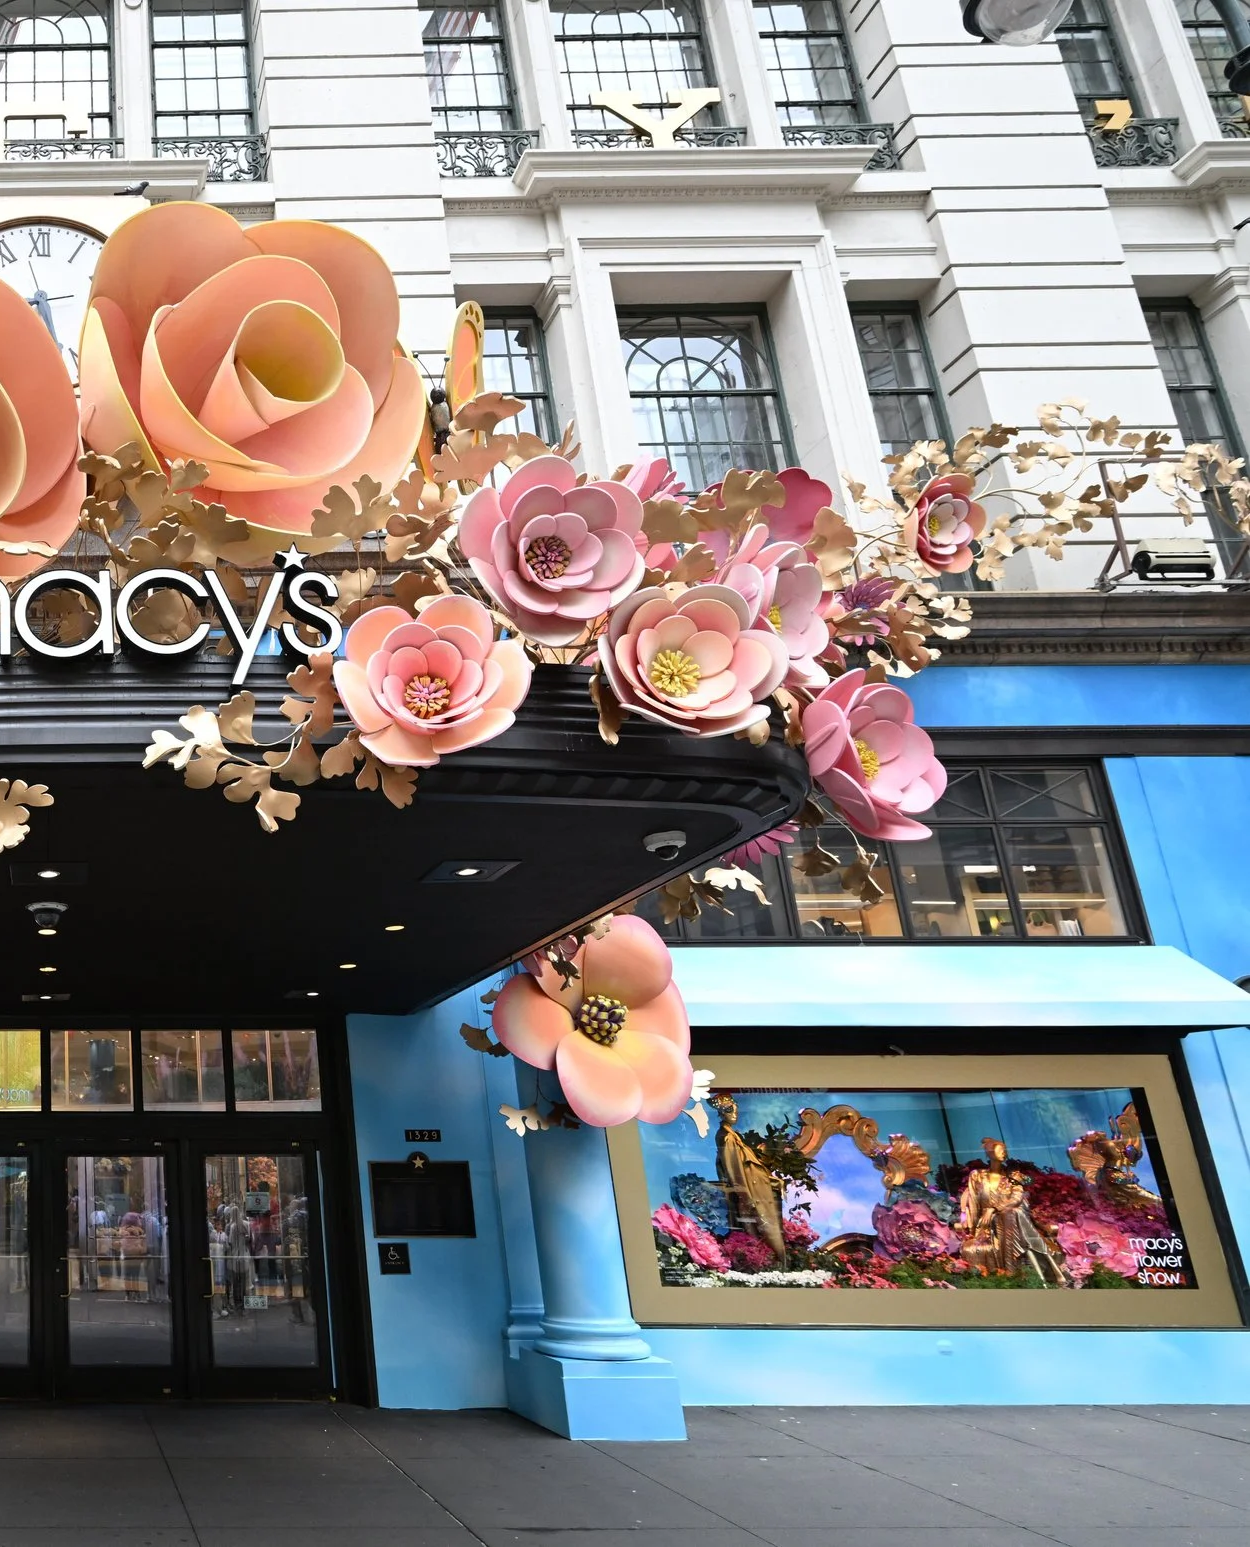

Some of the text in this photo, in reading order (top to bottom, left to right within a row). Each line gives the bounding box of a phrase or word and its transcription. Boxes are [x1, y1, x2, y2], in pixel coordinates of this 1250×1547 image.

[589, 88, 721, 148] Y
[28, 232, 51, 257] XII
[409, 1130, 438, 1140] 1329
[1132, 1252, 1182, 1267] flower
[1137, 1269, 1180, 1284] show
